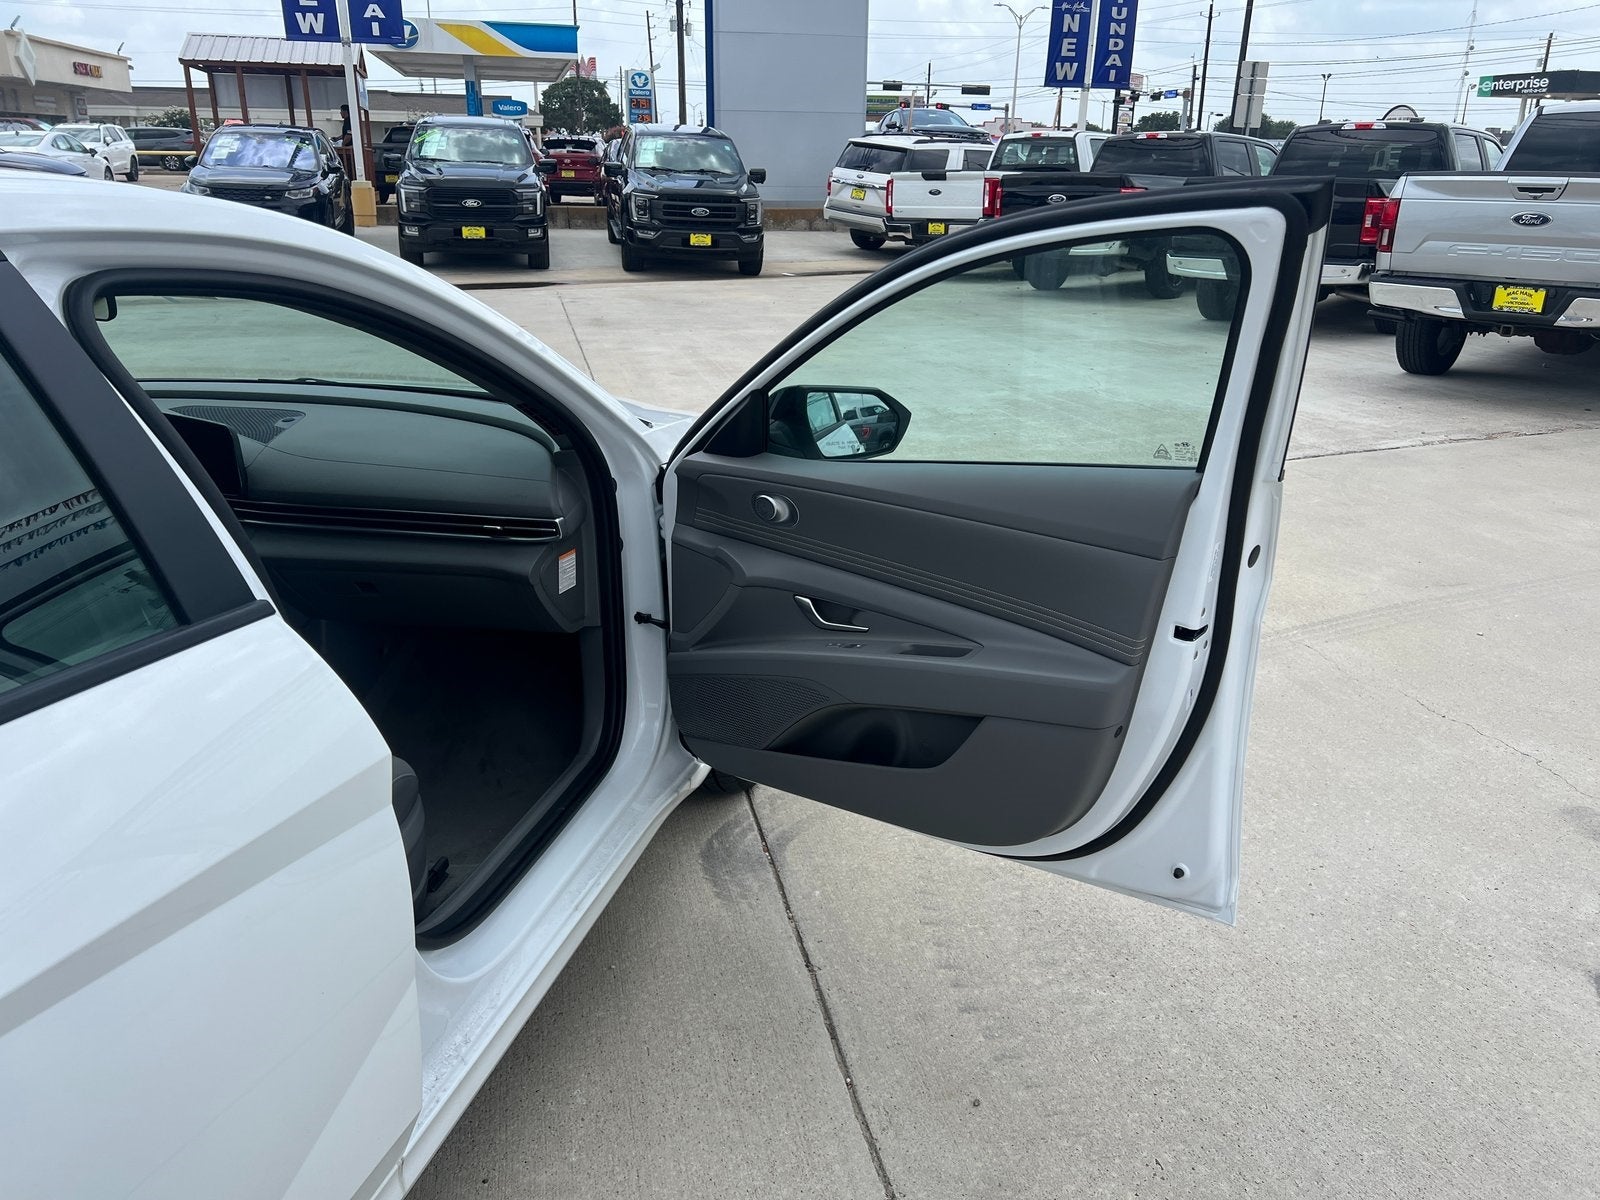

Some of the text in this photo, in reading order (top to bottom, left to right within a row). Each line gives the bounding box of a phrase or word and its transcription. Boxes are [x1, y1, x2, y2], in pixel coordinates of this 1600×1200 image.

[1055, 14, 1080, 81] NEW
[1104, 0, 1128, 82] UNDAI
[1480, 76, 1549, 92] enterprise
[498, 104, 522, 112] Valero
